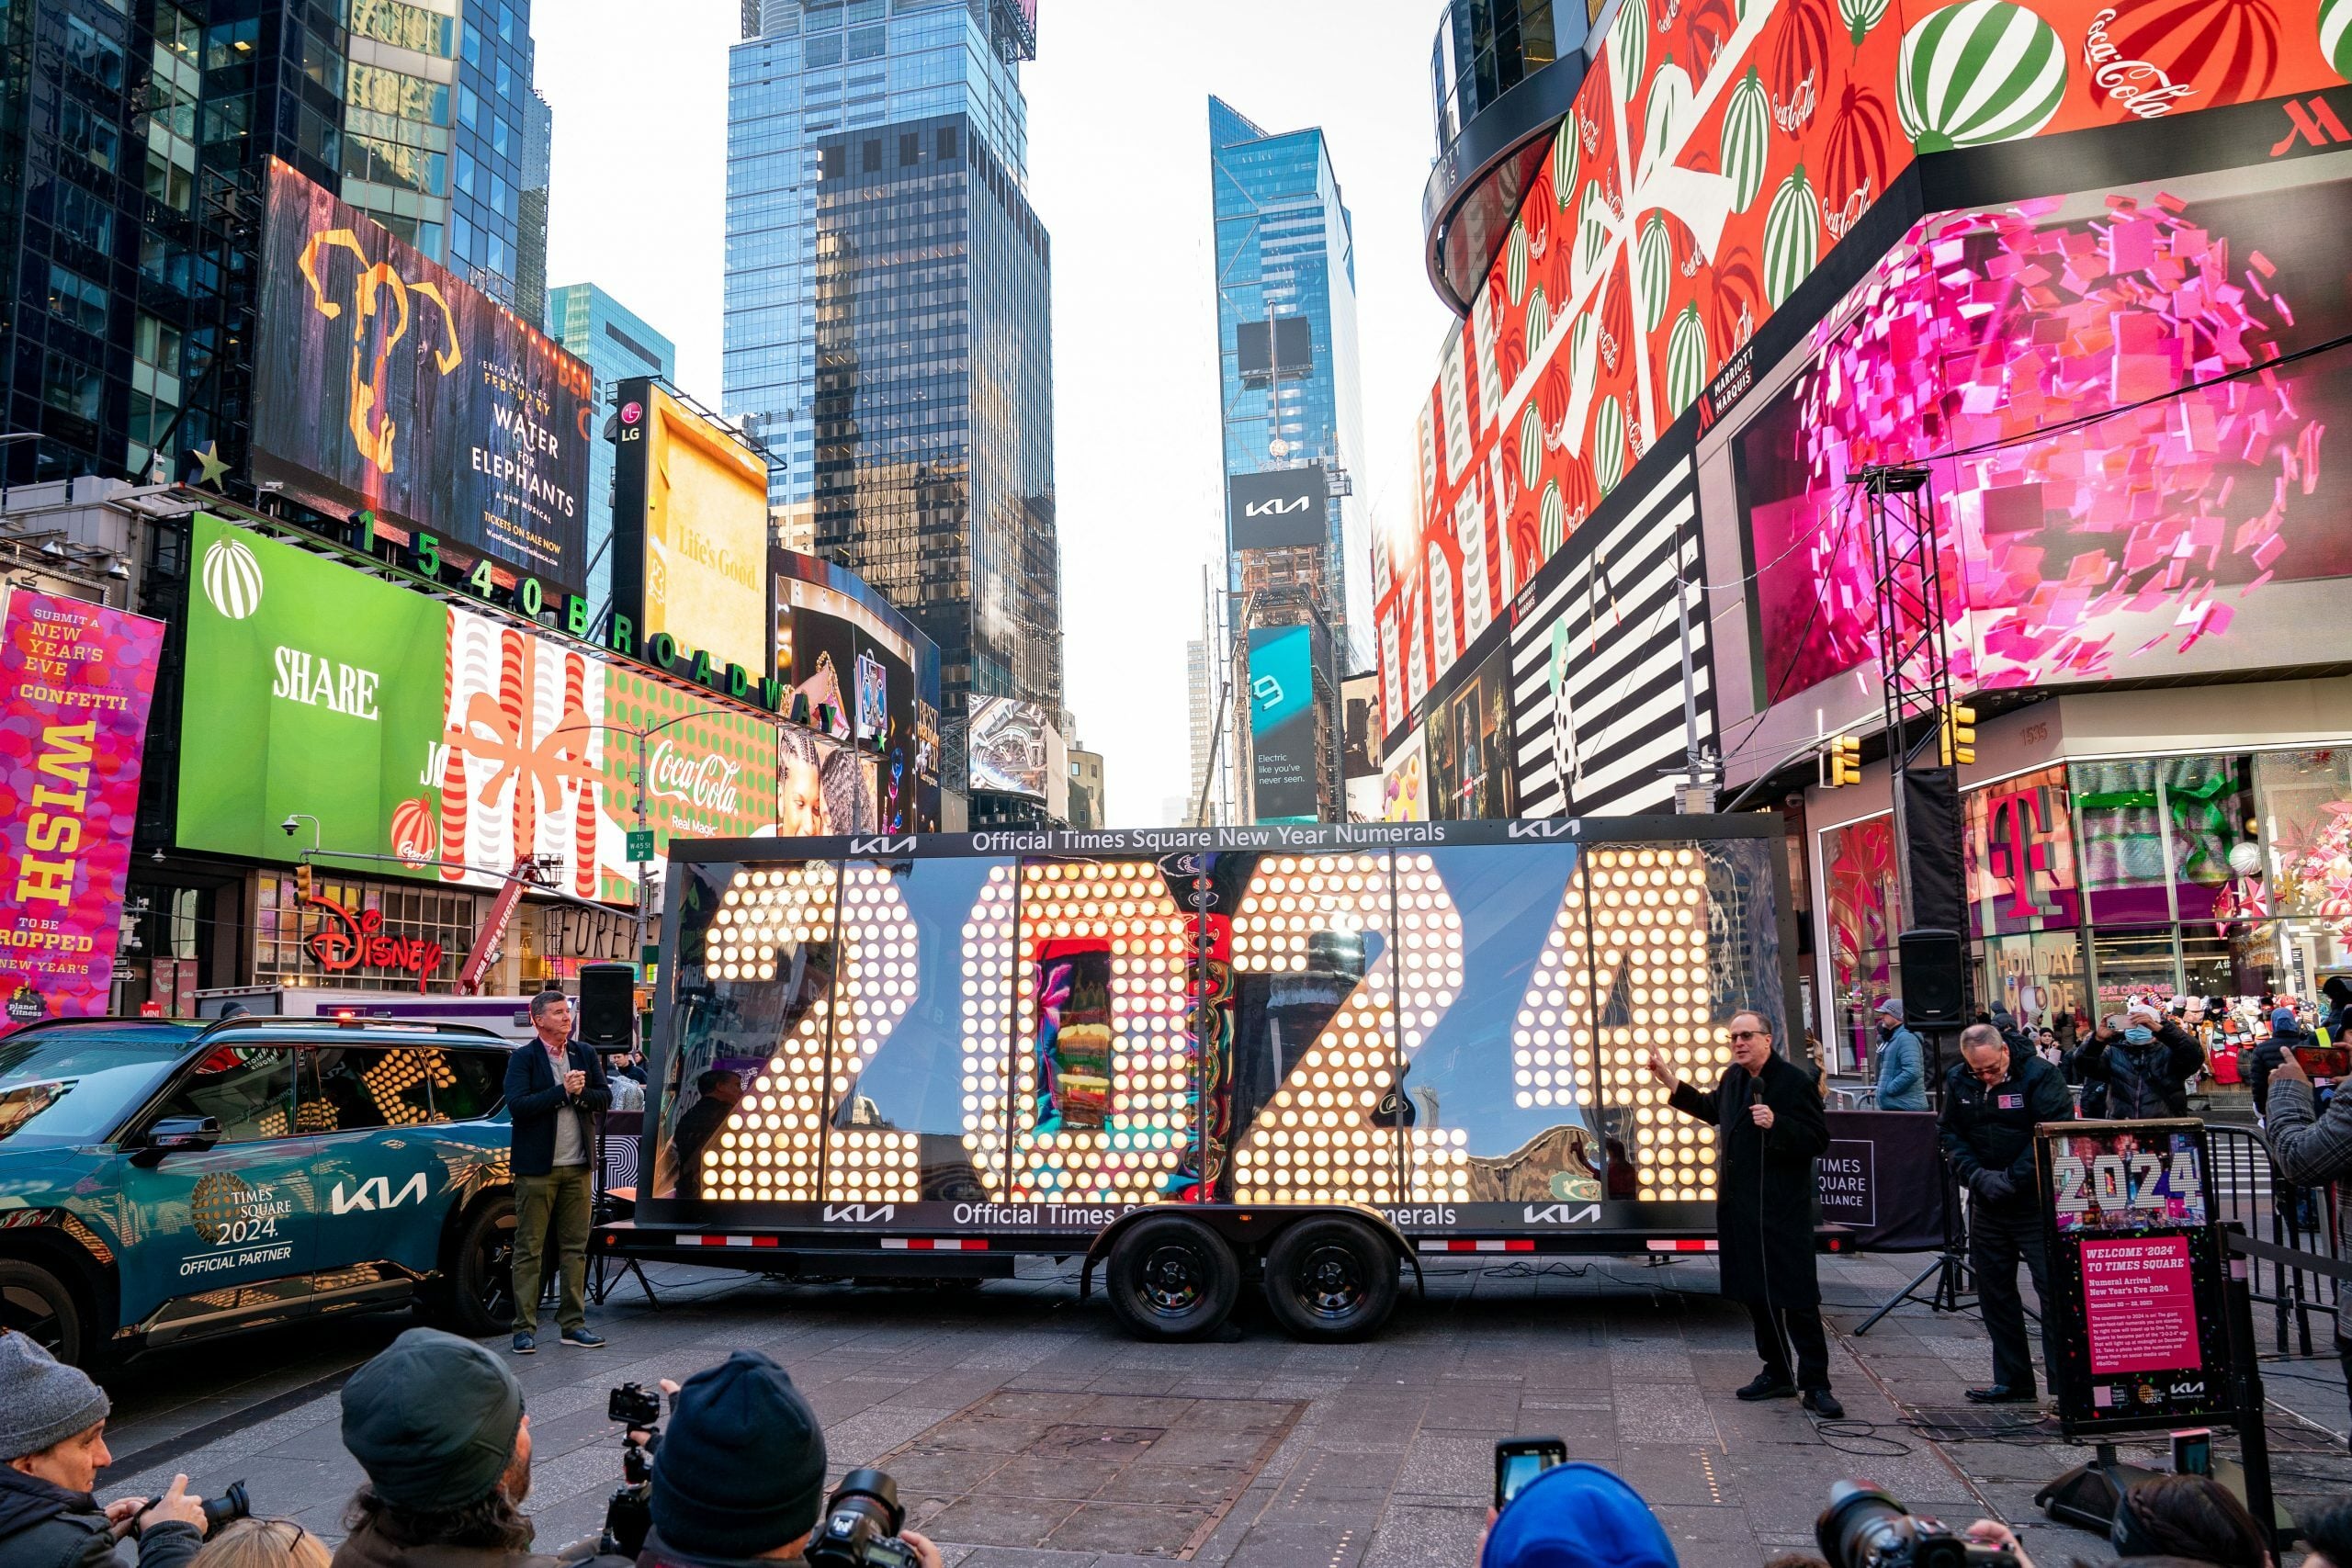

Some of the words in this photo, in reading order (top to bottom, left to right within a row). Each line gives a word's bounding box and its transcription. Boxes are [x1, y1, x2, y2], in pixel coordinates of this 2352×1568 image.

[2084, 8, 2199, 118] Coca-Cola
[1772, 62, 1816, 132] Coca-Cola
[1714, 345, 1754, 397] MARRIOTT
[484, 372, 550, 416] FEBRUARY
[1715, 370, 1751, 414] MARQUIS
[493, 402, 559, 459] WATER
[621, 427, 640, 442] LG
[517, 450, 535, 468] FOR
[472, 446, 574, 517] ELEPHANTS
[503, 493, 519, 505] NEW
[522, 502, 551, 524] MUSICAL
[1245, 495, 1310, 517] KIA
[484, 512, 512, 532] TICKETS
[513, 525, 525, 538] ON
[526, 531, 542, 547] SALE
[543, 540, 561, 555] NOW
[678, 525, 717, 576] Life's
[1518, 580, 1536, 606] MARRIOTT
[34, 608, 88, 626] SUBMIT
[90, 619, 99, 628] A
[30, 621, 83, 642] NEW
[28, 638, 104, 662] YEAR'S
[24, 656, 68, 677] EVE
[563, 594, 837, 733] BROADWAY
[273, 645, 379, 720] SHARE
[20, 683, 129, 711] CONFETTI
[2022, 721, 2048, 746] 1535
[1258, 754, 1287, 763] Electric
[649, 739, 742, 817] Coca-Cola
[1274, 764, 1301, 775] you've
[1283, 775, 1306, 784] seen.
[15, 720, 96, 907] WISH
[672, 815, 690, 830] Real
[972, 830, 1053, 852] Official
[1060, 829, 1125, 850] Times
[1132, 828, 1212, 853] Square
[1218, 827, 1270, 846] New
[1276, 825, 1328, 845] Year
[1335, 822, 1445, 844] Numerals
[1508, 818, 1581, 839] KIA
[850, 836, 917, 854] KIA
[499, 885, 523, 928] ELECTRIC
[18, 917, 38, 928] TO
[40, 919, 59, 931] BE
[496, 929, 503, 939] &
[483, 937, 499, 961] SIGN
[0, 959, 32, 971] NEW
[38, 961, 89, 975] YEAR'S
[1996, 944, 2076, 978] HOLIDAY
[473, 961, 487, 986] AMA
[8, 1002, 38, 1011] planet
[12, 1008, 42, 1018] fitness
[142, 1010, 160, 1018] MINI
[701, 845, 1729, 1203] 2024
[1817, 1158, 1860, 1173] TIMES
[1818, 1177, 1866, 1192] QUARE
[2052, 1151, 2201, 1212] 2024
[232, 1188, 273, 1205] TIMES
[331, 1172, 428, 1215] KIA
[1819, 1195, 1863, 1207] LLIANCE
[241, 1200, 292, 1219] SQUARE
[823, 1203, 895, 1223] KIA
[953, 1202, 1038, 1224] Official
[1046, 1202, 1115, 1224] Times
[1523, 1203, 1601, 1224] KIA
[179, 1254, 236, 1277] OFFICIAL
[239, 1246, 292, 1268] PARTNER
[2086, 1246, 2142, 1259] WELCOME
[2087, 1262, 2102, 1273] TO
[2105, 1259, 2141, 1271] TIMES
[2143, 1258, 2185, 1269] SQUARE
[2088, 1278, 2122, 1287] Numeral
[2124, 1276, 2151, 1285] Arrival
[2089, 1288, 2106, 1296] New
[2109, 1286, 2132, 1295] Year's
[2133, 1285, 2147, 1294] Eve
[2150, 1284, 2169, 1293] 2024
[2170, 1382, 2205, 1394] KIA
[2144, 1396, 2163, 1404] 2024
